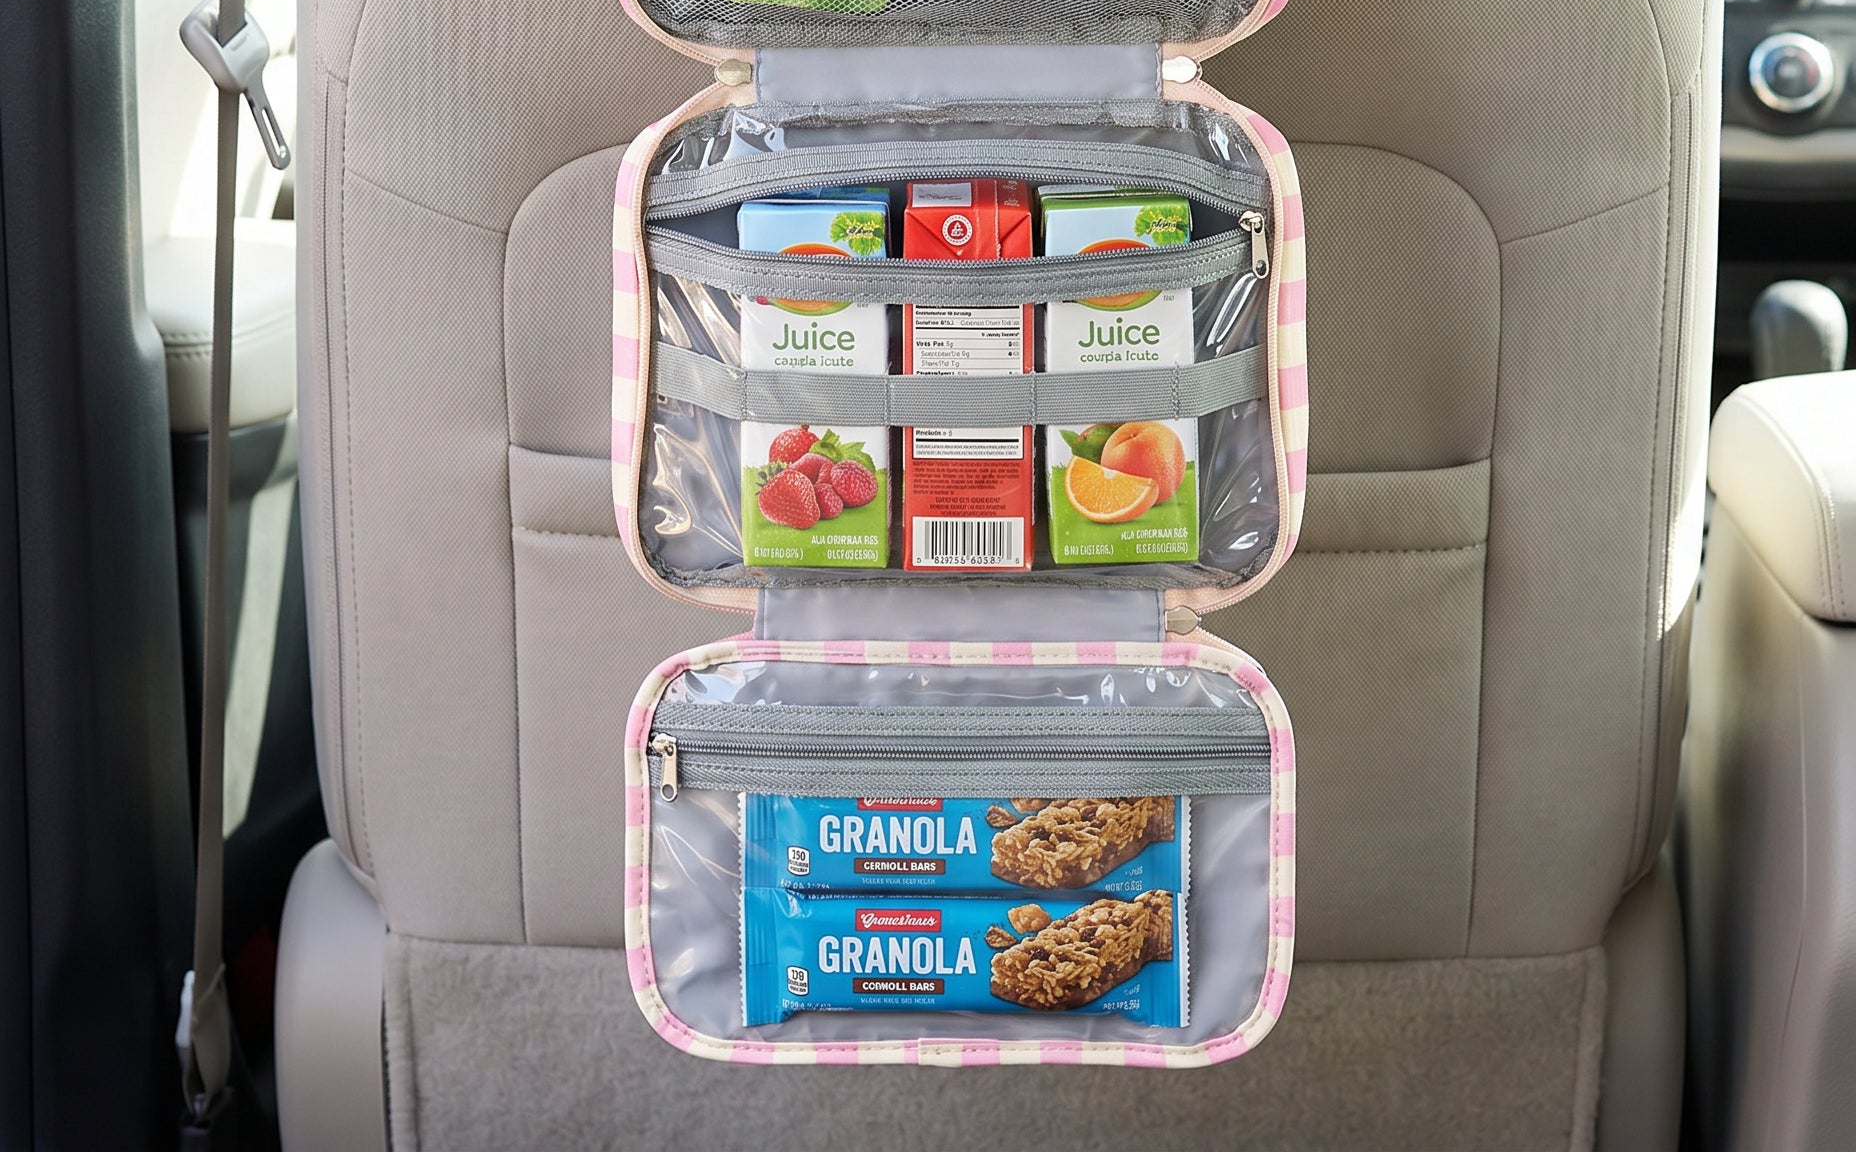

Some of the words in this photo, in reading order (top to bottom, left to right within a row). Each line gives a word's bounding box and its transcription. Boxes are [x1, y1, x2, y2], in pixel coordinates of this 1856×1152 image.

[772, 321, 856, 351] Juice
[1078, 316, 1161, 348] Juice
[819, 814, 977, 855] GRANOLA
[910, 862, 936, 872] BARS
[818, 935, 977, 975] GRANOLA
[909, 982, 936, 992] BARS
